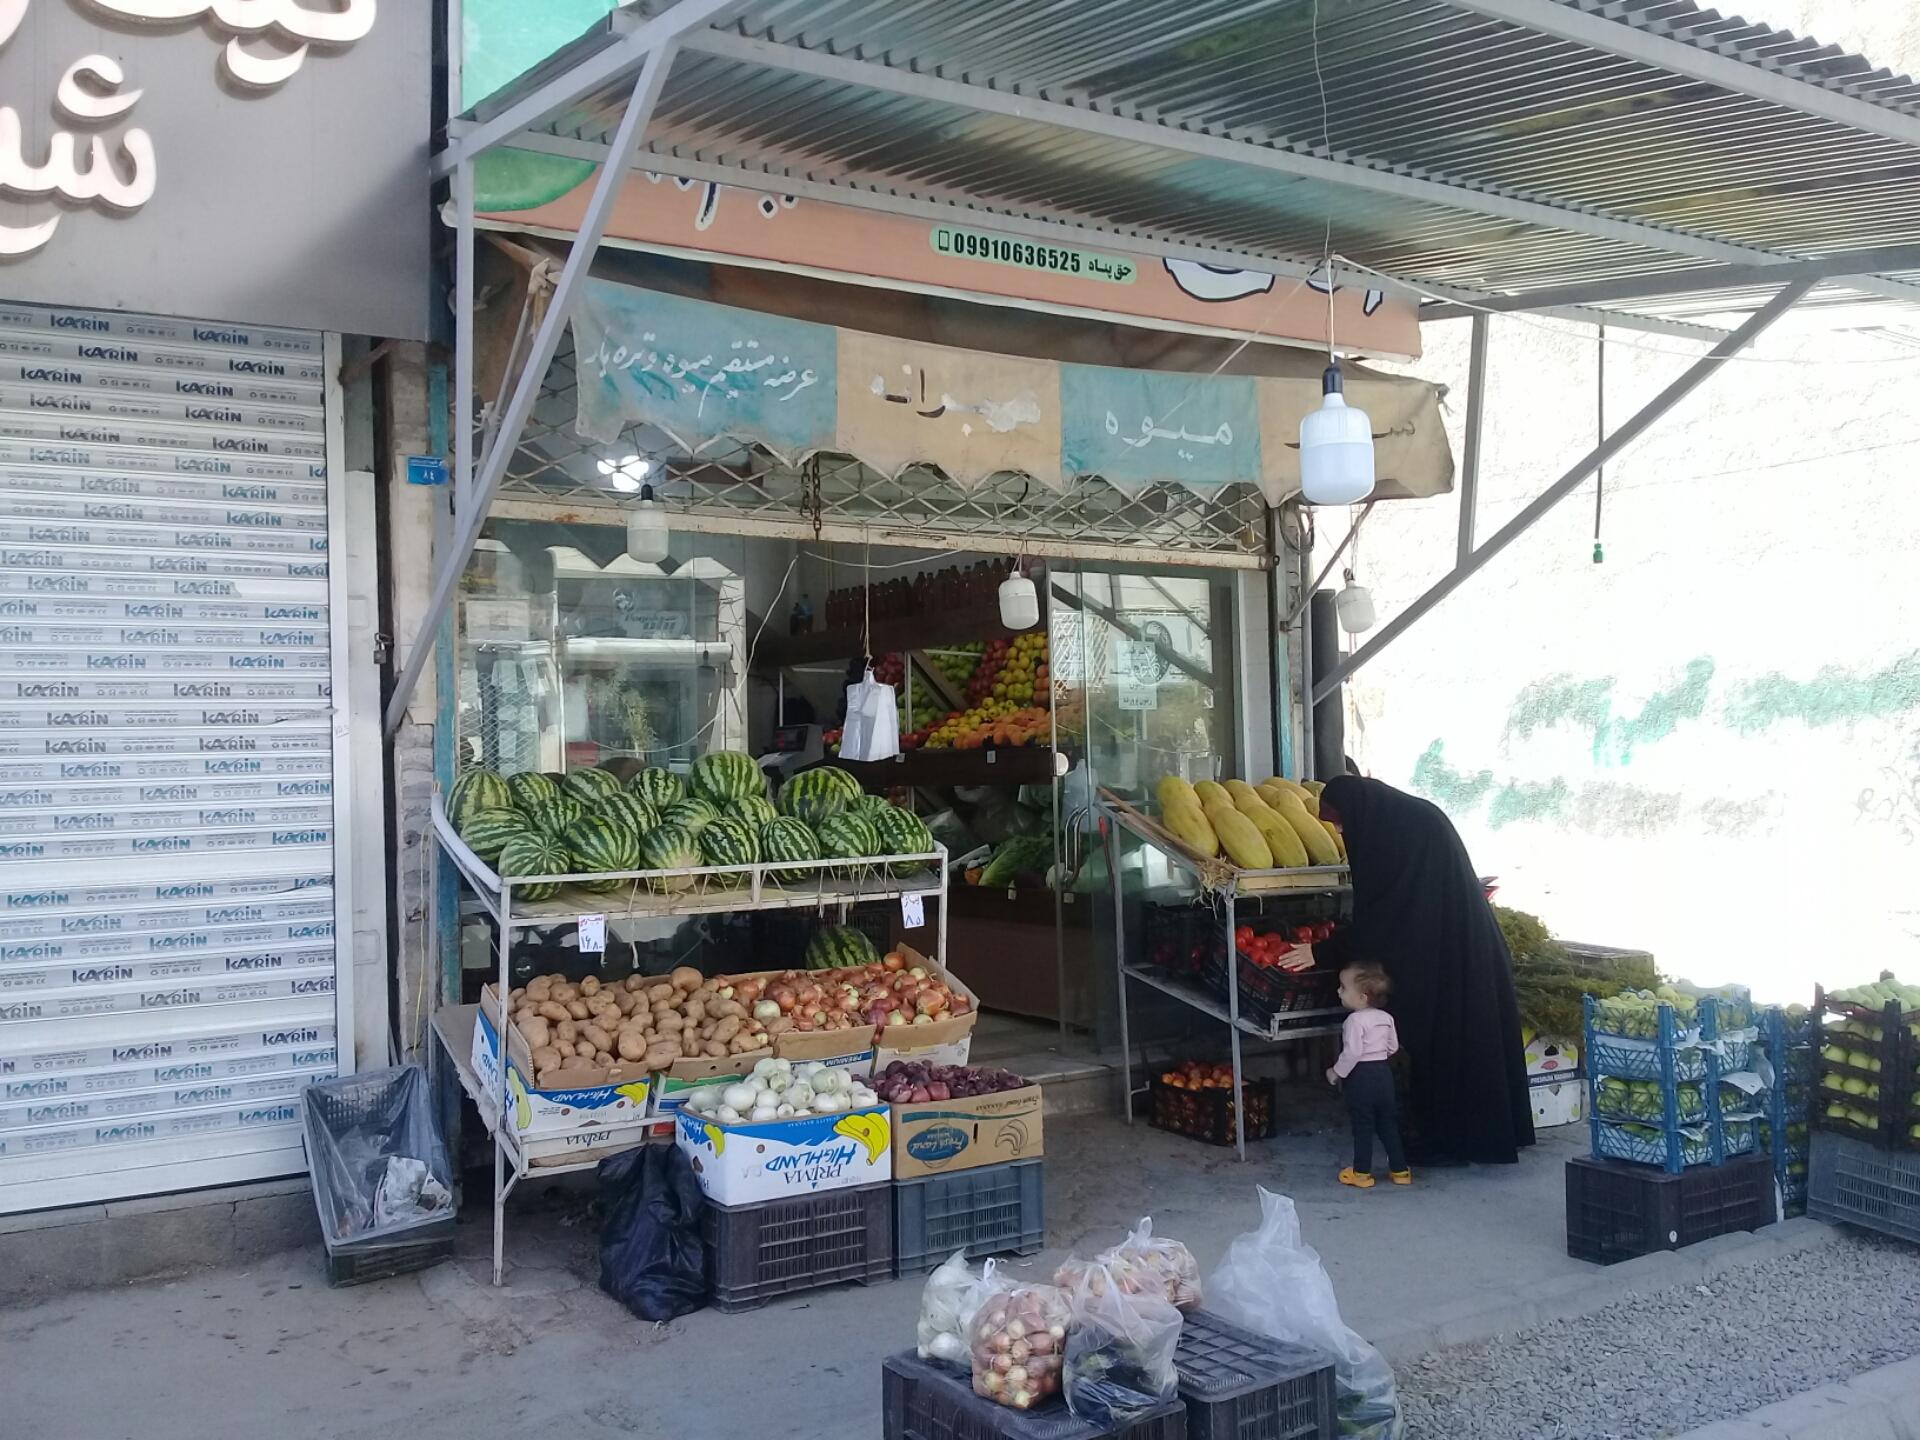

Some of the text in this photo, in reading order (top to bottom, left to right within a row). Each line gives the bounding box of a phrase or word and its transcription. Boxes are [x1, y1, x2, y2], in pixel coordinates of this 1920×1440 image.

[954, 233, 1081, 273] 09910636525
[698, 339, 775, 418] مستقیم
[763, 354, 818, 401] عرضه
[1101, 410, 1234, 462] میوه
[552, 1089, 612, 1102] HIGHLAND
[566, 1131, 612, 1147] PRIMA
[766, 1142, 857, 1172] HIGHLAND
[784, 1164, 841, 1185] PRIMA
